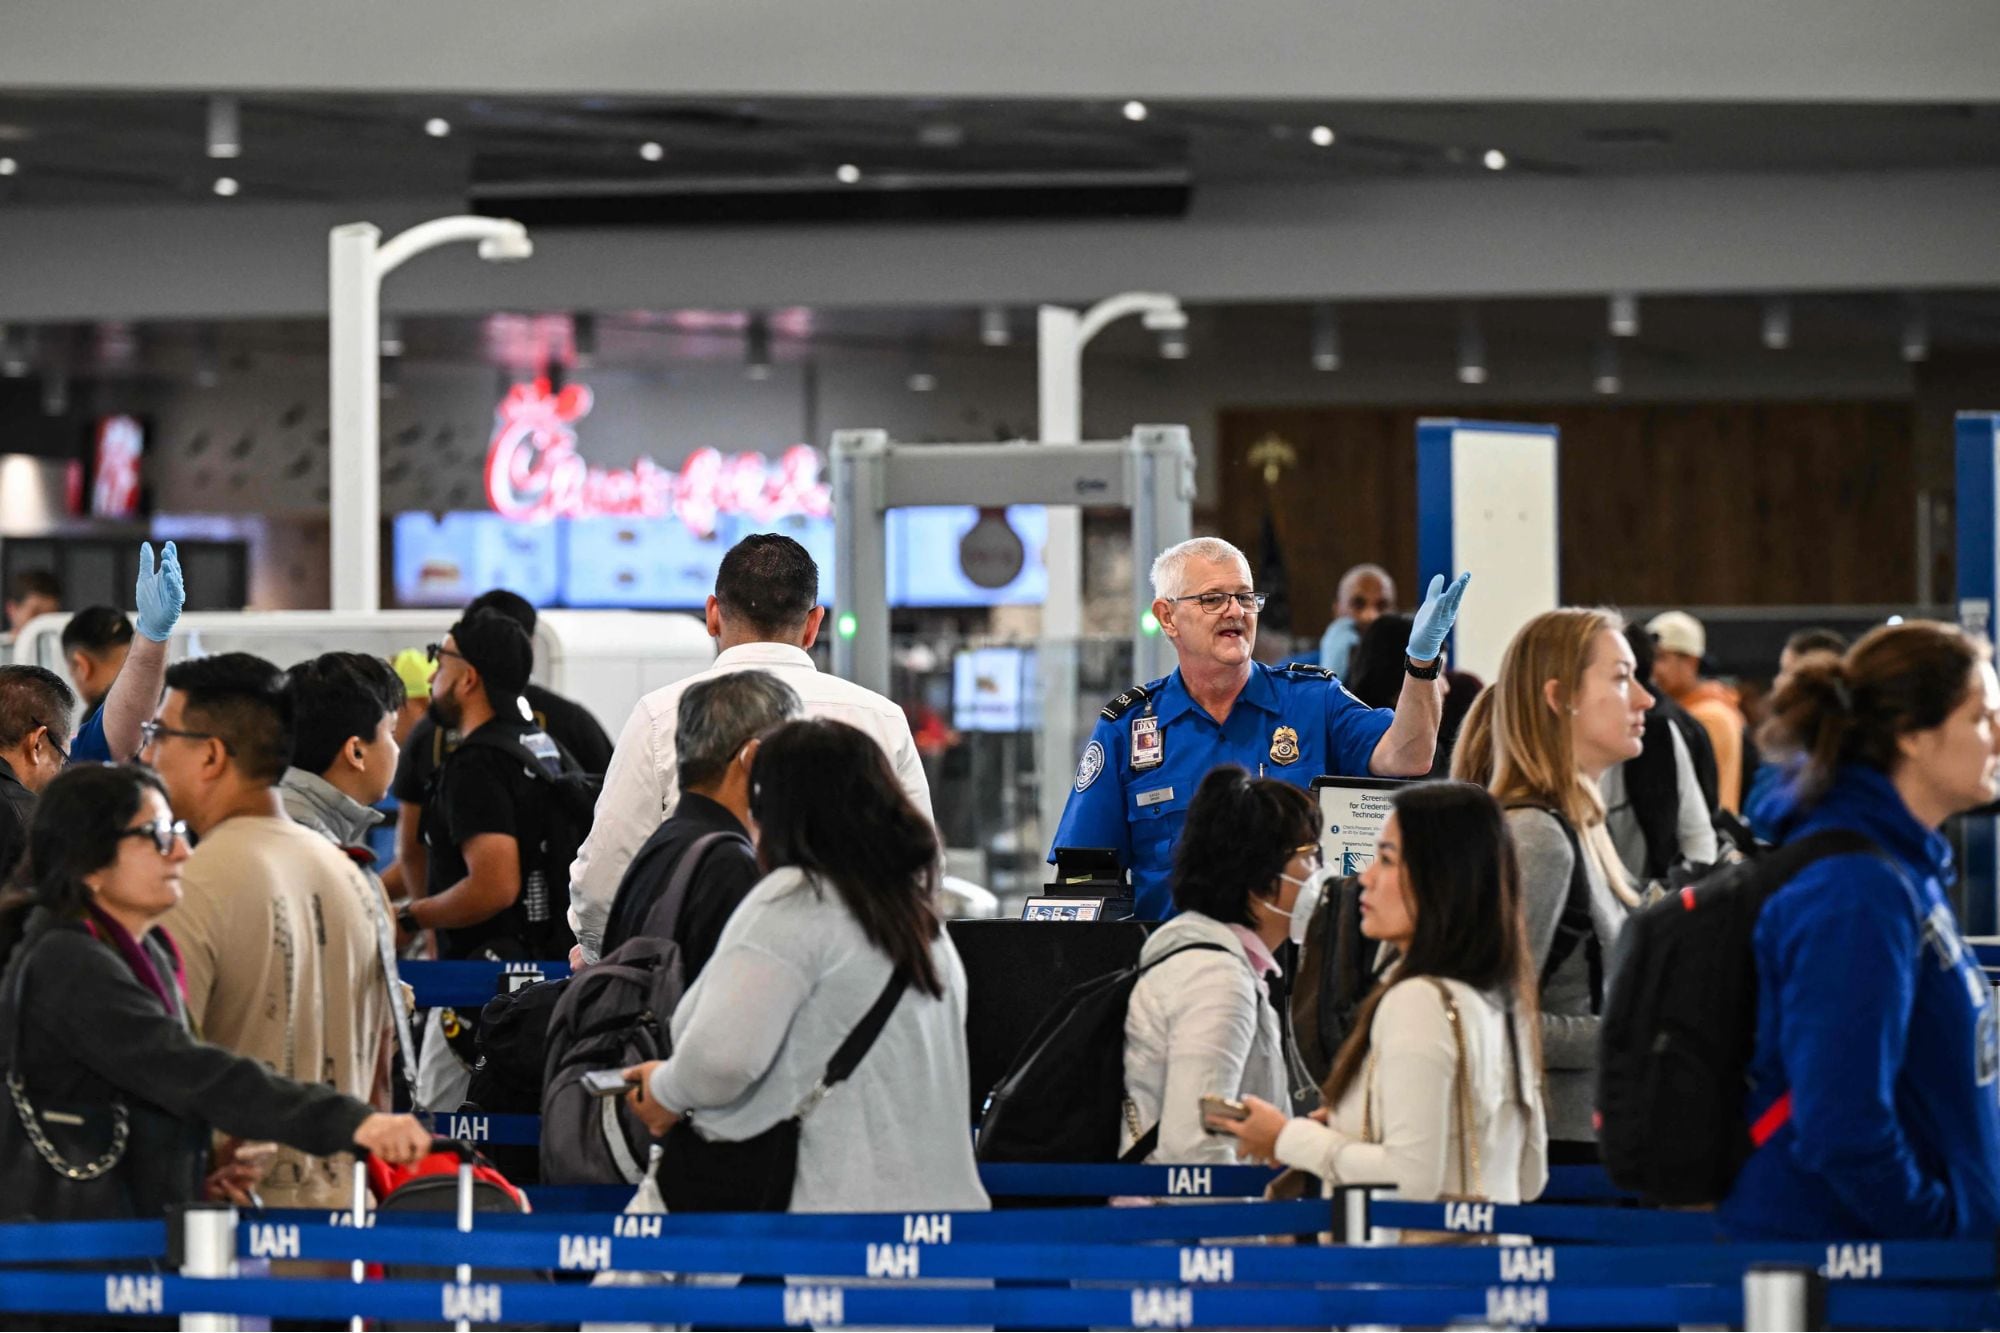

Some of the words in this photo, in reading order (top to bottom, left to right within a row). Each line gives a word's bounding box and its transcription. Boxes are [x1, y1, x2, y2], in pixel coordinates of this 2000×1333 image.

[1115, 693, 1133, 707] TSA
[1138, 720, 1158, 732] DAY
[1352, 811, 1385, 820] Technolog
[1360, 803, 1393, 811] Credentia
[450, 1115, 489, 1141] IAH
[1167, 1166, 1212, 1196] IAH
[614, 1215, 662, 1238] IAH
[903, 1213, 951, 1244] IAH
[1445, 1201, 1494, 1234] IAH
[249, 1224, 300, 1259] IAH
[559, 1235, 611, 1271] IAH
[866, 1244, 919, 1278] IAH
[1180, 1248, 1234, 1282] IAH
[1499, 1247, 1554, 1281] IAH
[1826, 1243, 1881, 1278] IAH
[106, 1275, 163, 1313] IAH
[442, 1283, 502, 1323] IAH
[784, 1287, 843, 1326] IAH
[1132, 1289, 1193, 1328] IAH
[1485, 1287, 1548, 1325] IAH
